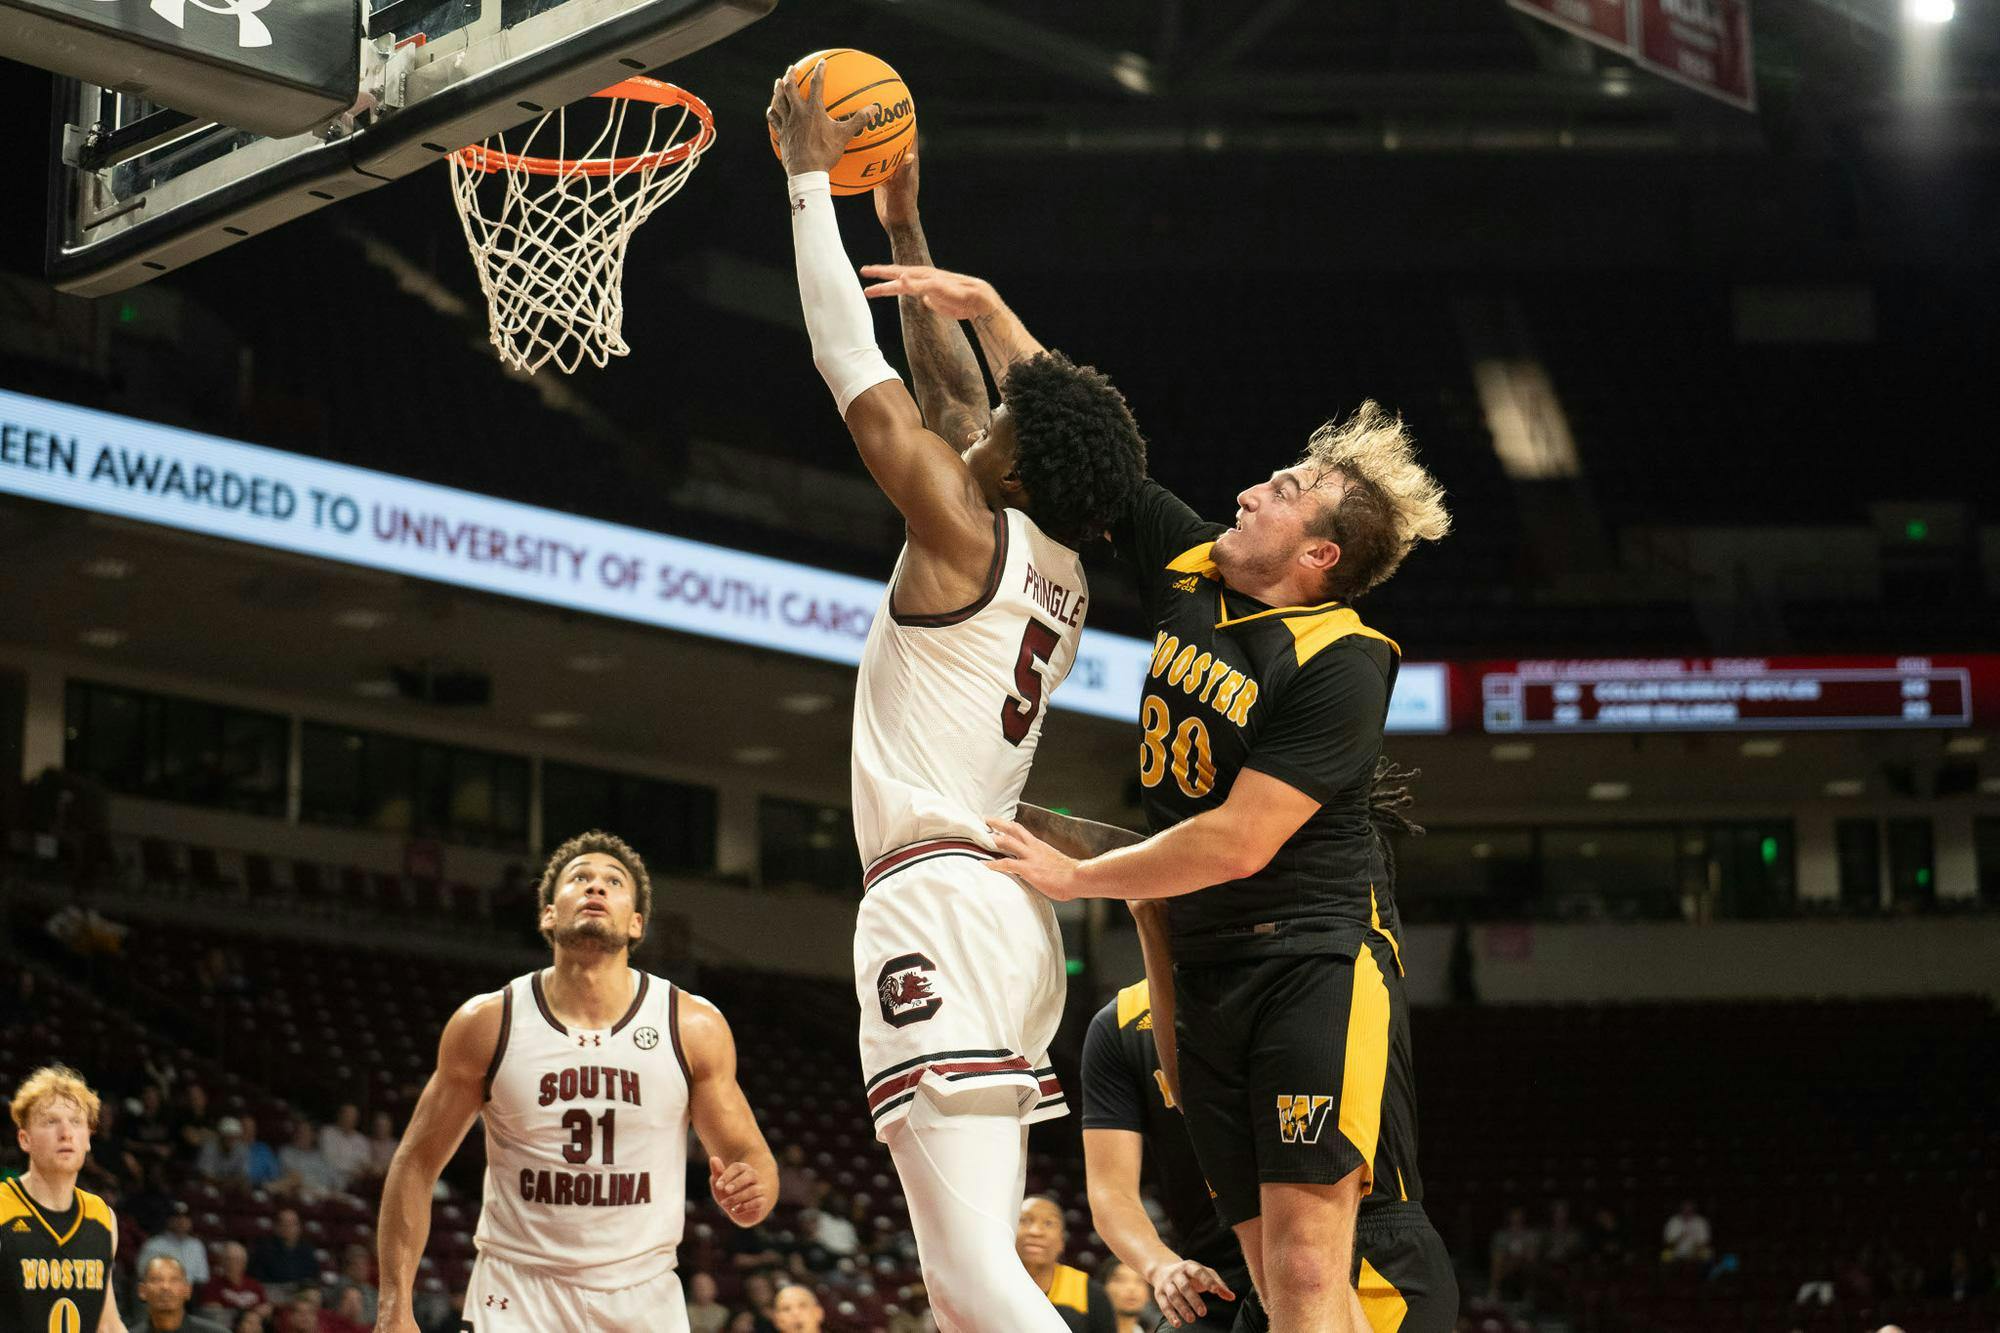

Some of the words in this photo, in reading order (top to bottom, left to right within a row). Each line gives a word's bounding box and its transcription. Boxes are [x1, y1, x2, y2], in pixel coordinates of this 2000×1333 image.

[90, 445, 296, 520] AWARDED
[310, 489, 360, 533] TO
[372, 503, 586, 579] UNIVERSITY
[600, 553, 642, 590] OF
[658, 564, 770, 618] SOUTH
[1023, 563, 1085, 628] PRINGLE
[1001, 616, 1061, 747] 5
[1140, 695, 1217, 798] 30
[538, 1066, 642, 1107] SOUTH
[562, 1108, 615, 1165] 31
[520, 1168, 652, 1206] CAROLINA
[21, 1258, 104, 1290] WOOSTER
